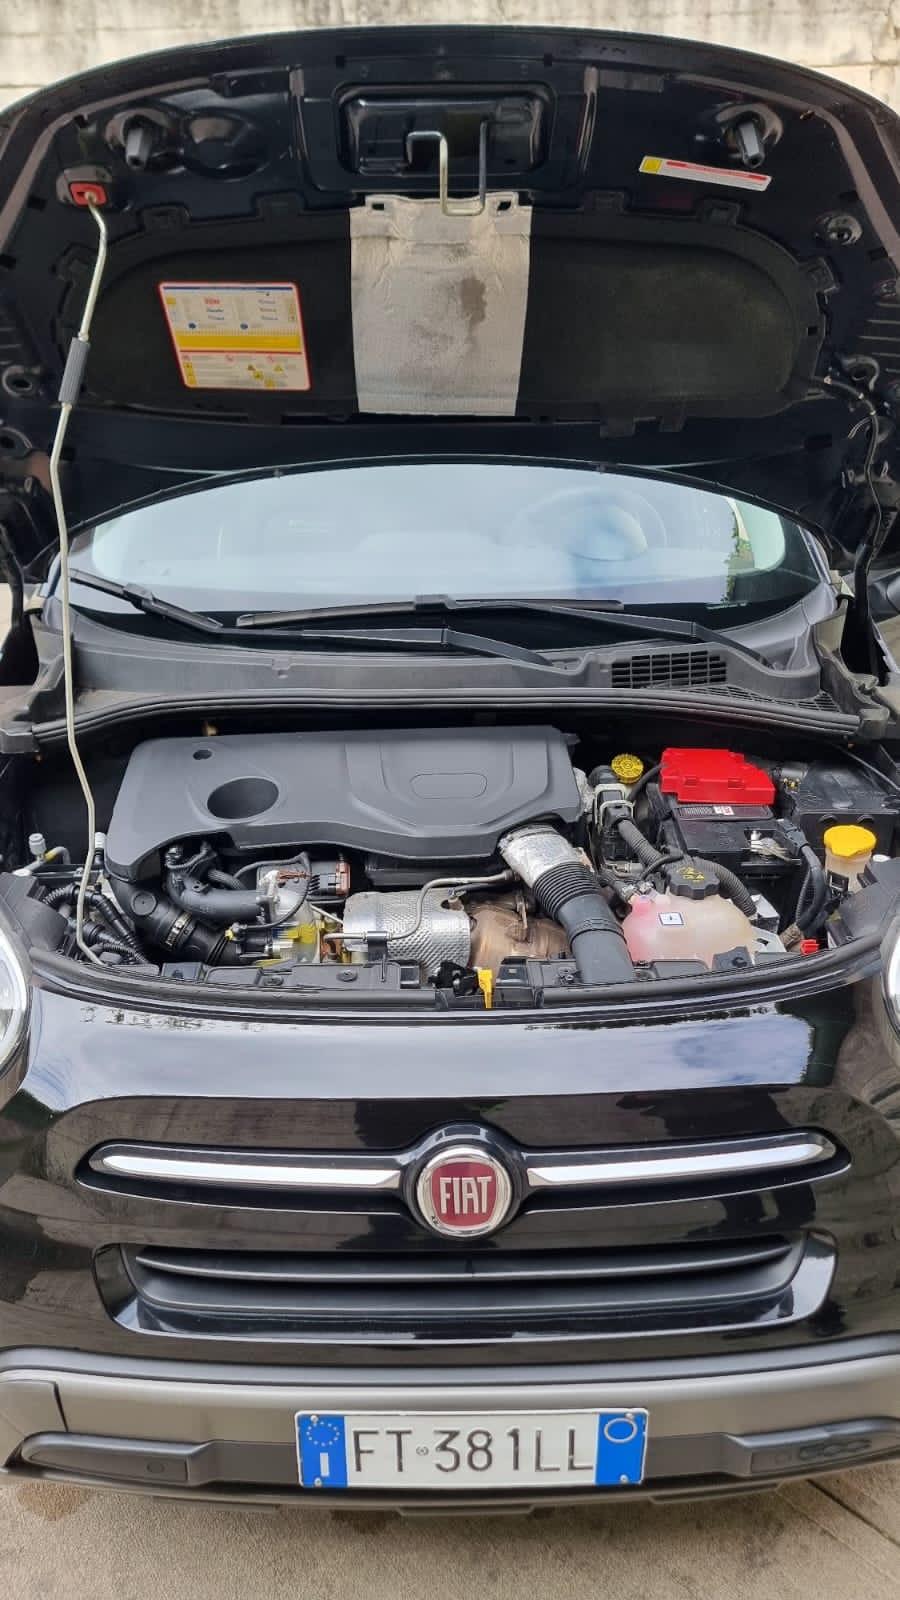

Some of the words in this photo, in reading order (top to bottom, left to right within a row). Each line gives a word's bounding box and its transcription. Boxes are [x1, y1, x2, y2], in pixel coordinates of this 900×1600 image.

[439, 1176, 492, 1215] FIAT
[320, 1452, 330, 1477] I
[352, 1429, 412, 1472] FT
[435, 1428, 594, 1472] 381LL
